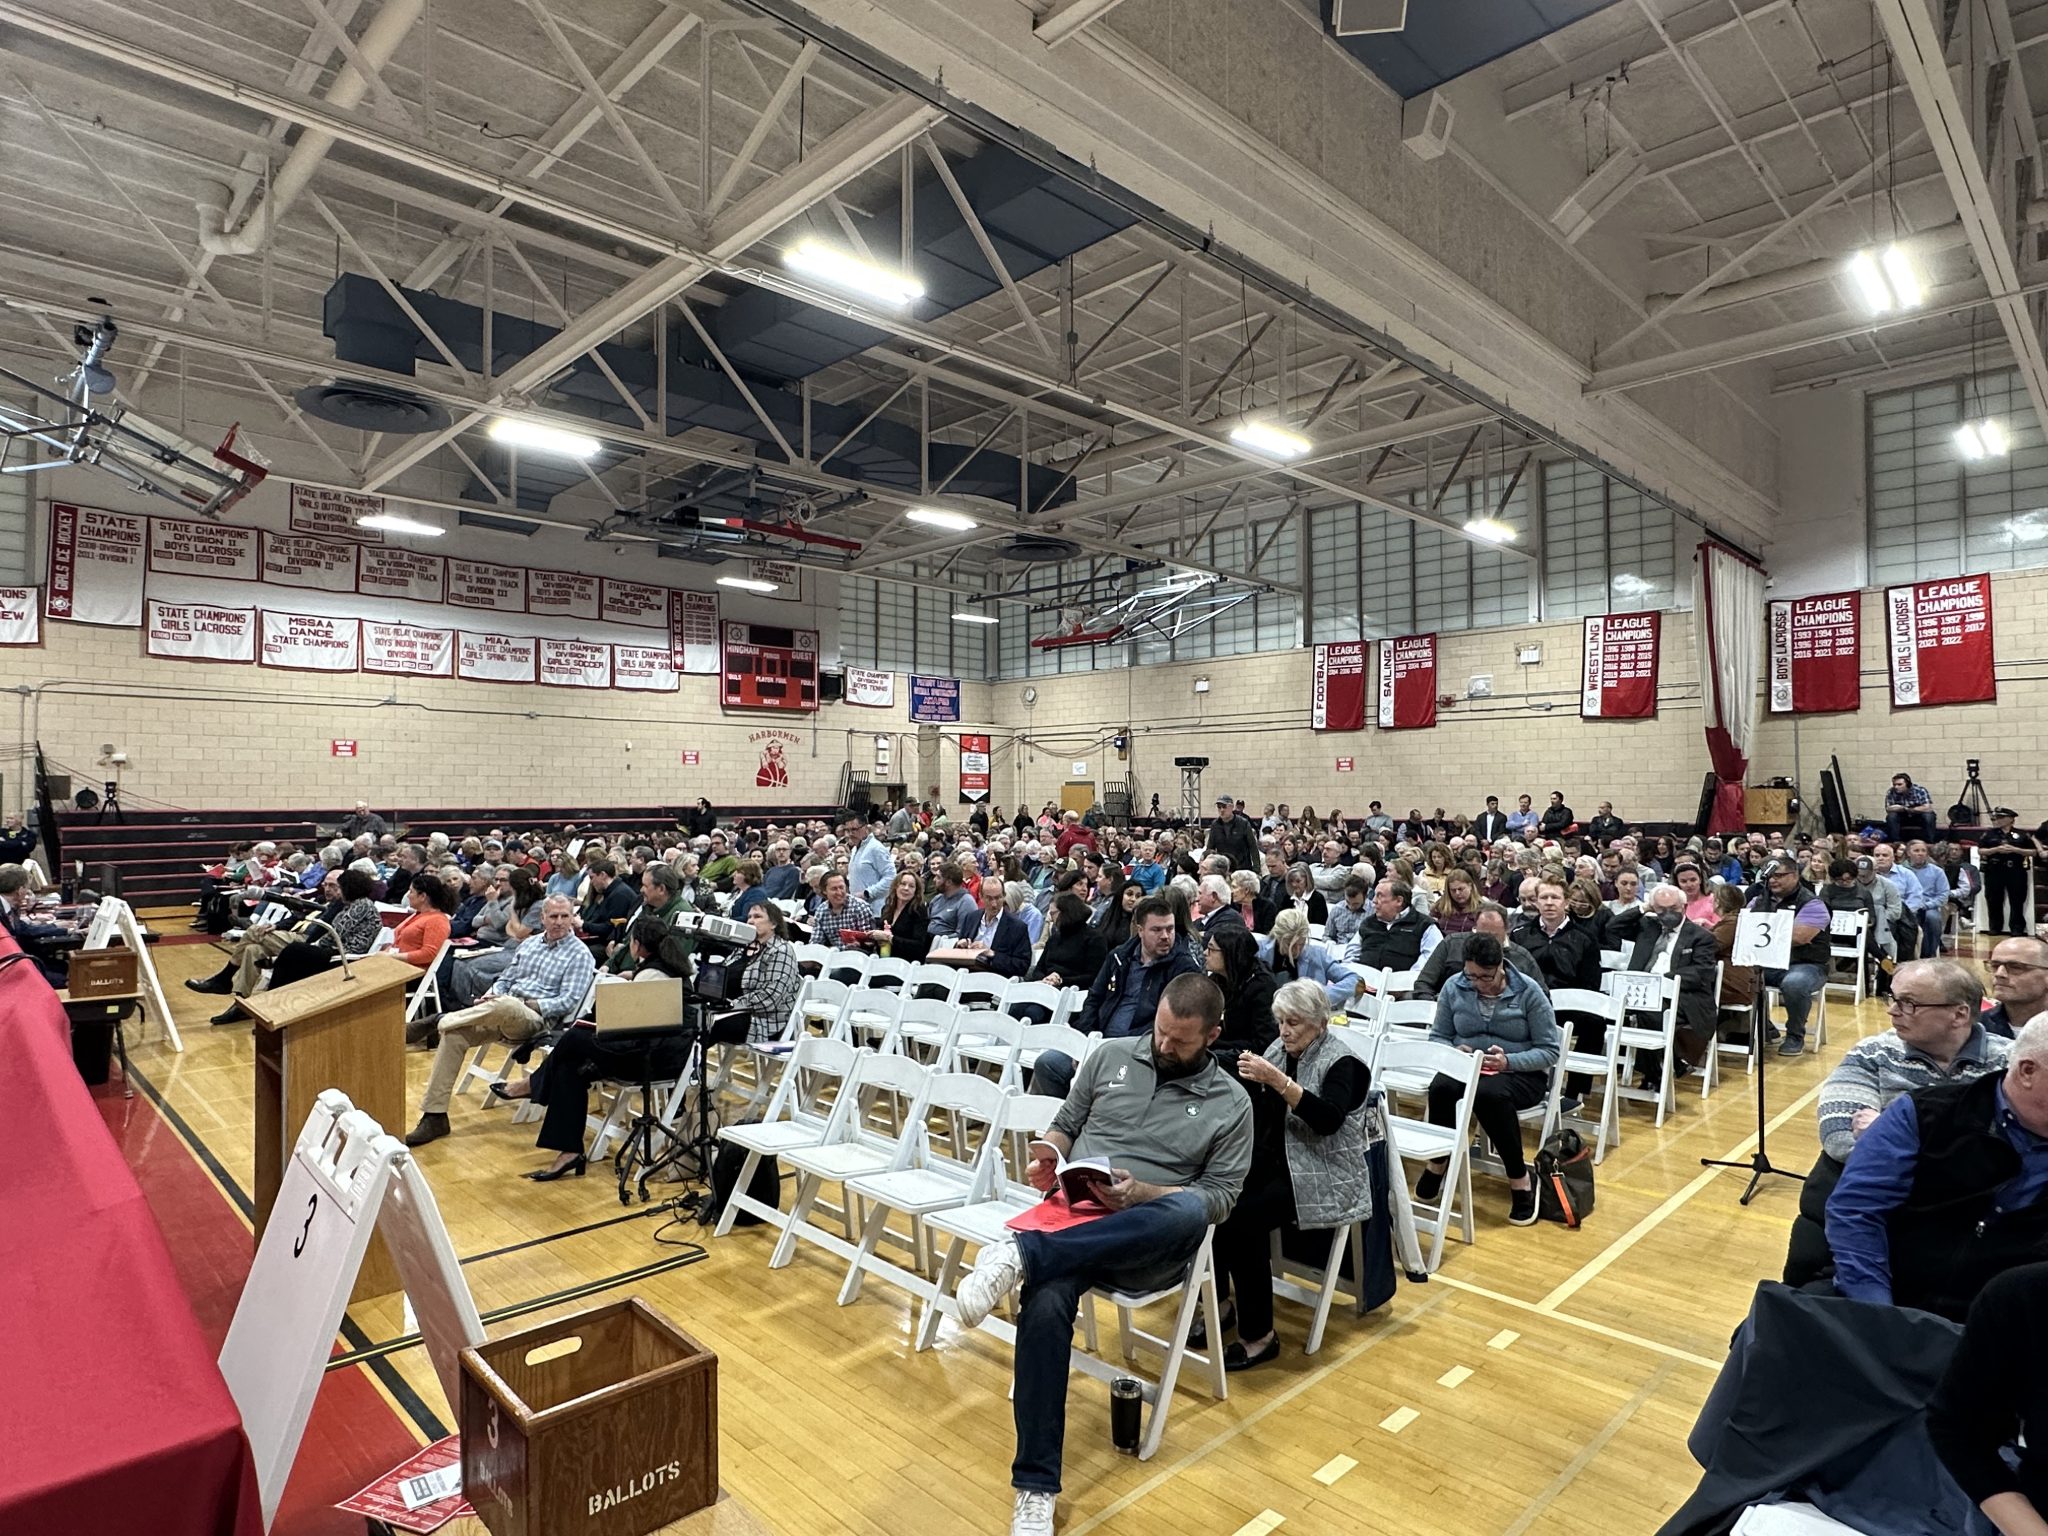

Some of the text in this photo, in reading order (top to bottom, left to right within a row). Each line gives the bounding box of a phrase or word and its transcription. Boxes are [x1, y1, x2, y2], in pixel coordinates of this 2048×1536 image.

[295, 486, 316, 498] STATE
[320, 491, 341, 500] RELAY
[299, 498, 351, 514] GIRLS OUTDOOR
[85, 513, 137, 530] STATE
[314, 512, 347, 523] DIVISION
[80, 525, 141, 542] CHAMPIONS
[160, 522, 249, 539] STATE CHAMPIONS
[173, 533, 223, 546] DIVISION
[273, 536, 350, 554] STATE RELAY CHAMPIONS
[55, 510, 72, 591] GIRLS ICE HOCKEY
[164, 541, 245, 557] BOYS LACROSSE
[270, 545, 351, 562] GIRLS OUTDOOR TRACK
[368, 550, 385, 559] STATE
[288, 557, 320, 568] DIVISION
[325, 562, 333, 570] III
[377, 560, 415, 570] DIVISION
[366, 566, 384, 575] BOYS
[416, 572, 437, 581] TRACK
[535, 573, 594, 586] STATE CHAMPIONS
[456, 574, 472, 583] GIRLS
[500, 580, 519, 588] TRACK
[543, 582, 574, 590] DIVISION
[608, 582, 627, 590] STATE
[467, 586, 494, 595] DIVISION
[574, 592, 592, 600] TRACK
[1919, 581, 1980, 600] LEAGUE
[687, 594, 714, 603] STATE
[1918, 595, 1983, 614] CHAMPIONS
[1796, 598, 1851, 613] LEAGUE
[158, 607, 246, 623] STATE CHAMPIONS
[1795, 611, 1853, 626] CHAMPIONS
[161, 619, 243, 635] GIRLS LACROSSE
[289, 617, 334, 628] MSSAA
[1607, 617, 1651, 630] LEAGUE
[1965, 622, 1986, 632] 2017
[290, 627, 333, 638] DANCE
[374, 626, 442, 640] STATE RELAY CHAMPIONS
[1606, 629, 1652, 641] CHAMPIONS
[1895, 597, 1912, 673] GIRLS LACROSSE
[273, 635, 349, 648] STATE CHAMPIONS
[375, 638, 392, 647] BOYS
[395, 640, 417, 648] INDOOR
[547, 642, 603, 653] STATE CHAMPIONS
[1397, 638, 1430, 650] LEAGUE
[1776, 610, 1788, 680] BOYS LACROSSE
[1836, 637, 1854, 646] 2000
[1918, 636, 1963, 648] 2021 2022
[387, 650, 417, 659] DIVISION
[500, 646, 531, 655] CHAMPIONS
[621, 649, 671, 659] STATE CHAMPION
[727, 645, 759, 655] HINGHAM
[792, 651, 812, 660] GUEST
[1330, 645, 1361, 655] LEAGUE
[1396, 648, 1432, 660] CHAMPIONS
[1814, 647, 1854, 657] 2021 2022
[466, 651, 483, 659] GIRLS
[510, 655, 529, 663] TRACK
[547, 658, 604, 668] GIRLS SOCCER
[1328, 655, 1362, 665] CHAMPIONS
[1589, 624, 1599, 691] WRESTLING
[621, 660, 636, 668] GIRLS
[1316, 648, 1325, 709] FOOTBALL
[1384, 650, 1392, 697] SAILING
[748, 730, 800, 744] HARBORMEN
[1754, 923, 1771, 947] 3
[294, 1193, 317, 1258] 3
[487, 1398, 499, 1449] 3
[589, 1460, 680, 1516] BALLOTS
